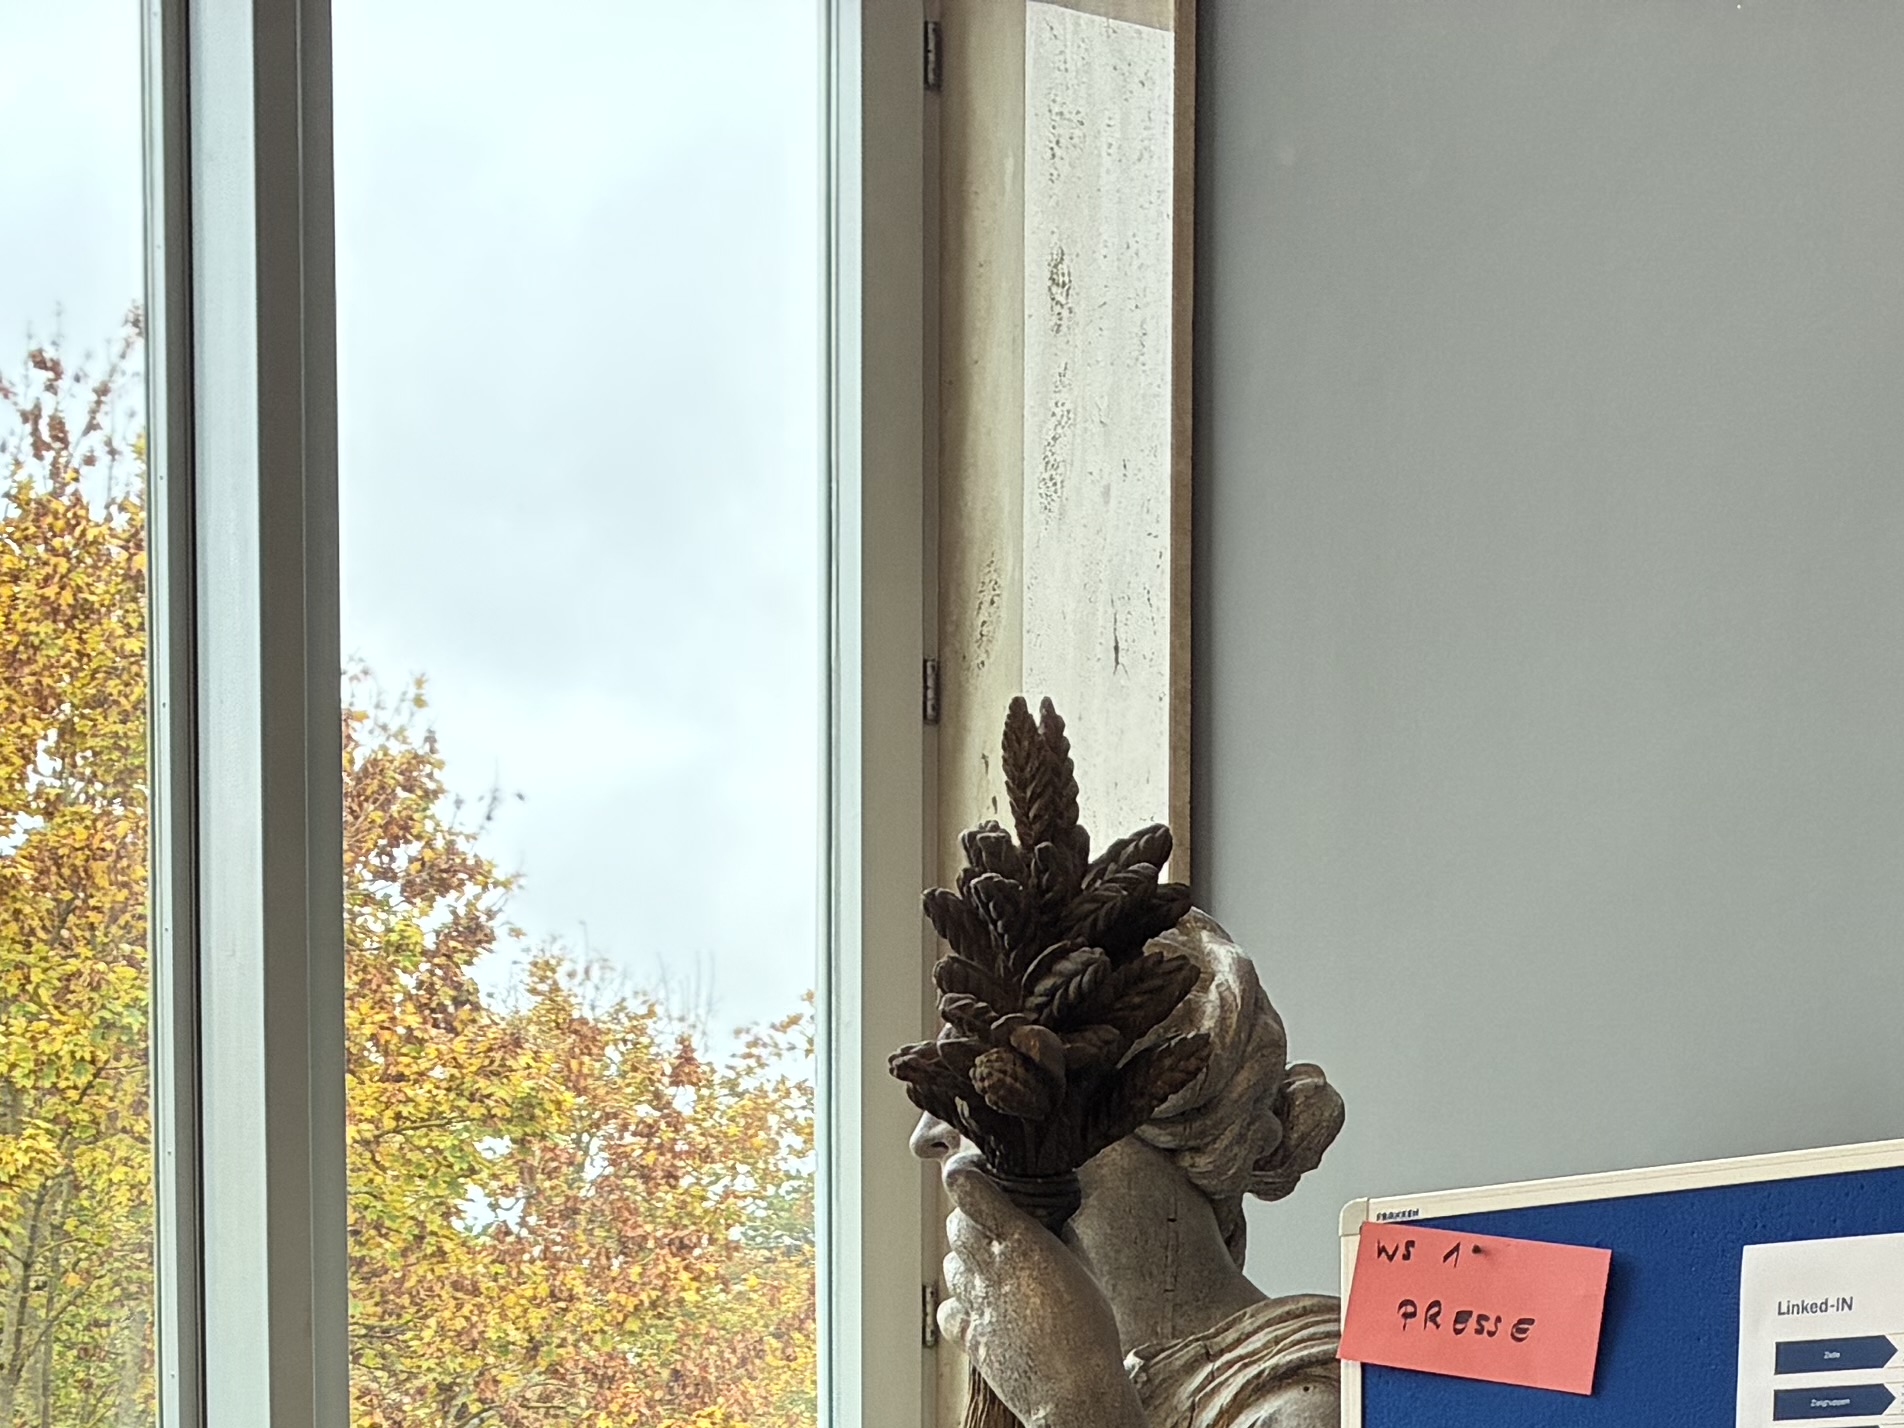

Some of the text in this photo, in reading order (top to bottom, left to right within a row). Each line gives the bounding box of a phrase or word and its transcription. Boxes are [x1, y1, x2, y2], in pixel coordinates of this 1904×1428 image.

[1376, 1239, 1416, 1263] WS
[1777, 1296, 1854, 1316] Linked-IN
[1397, 1298, 1536, 1343] PRESSE
